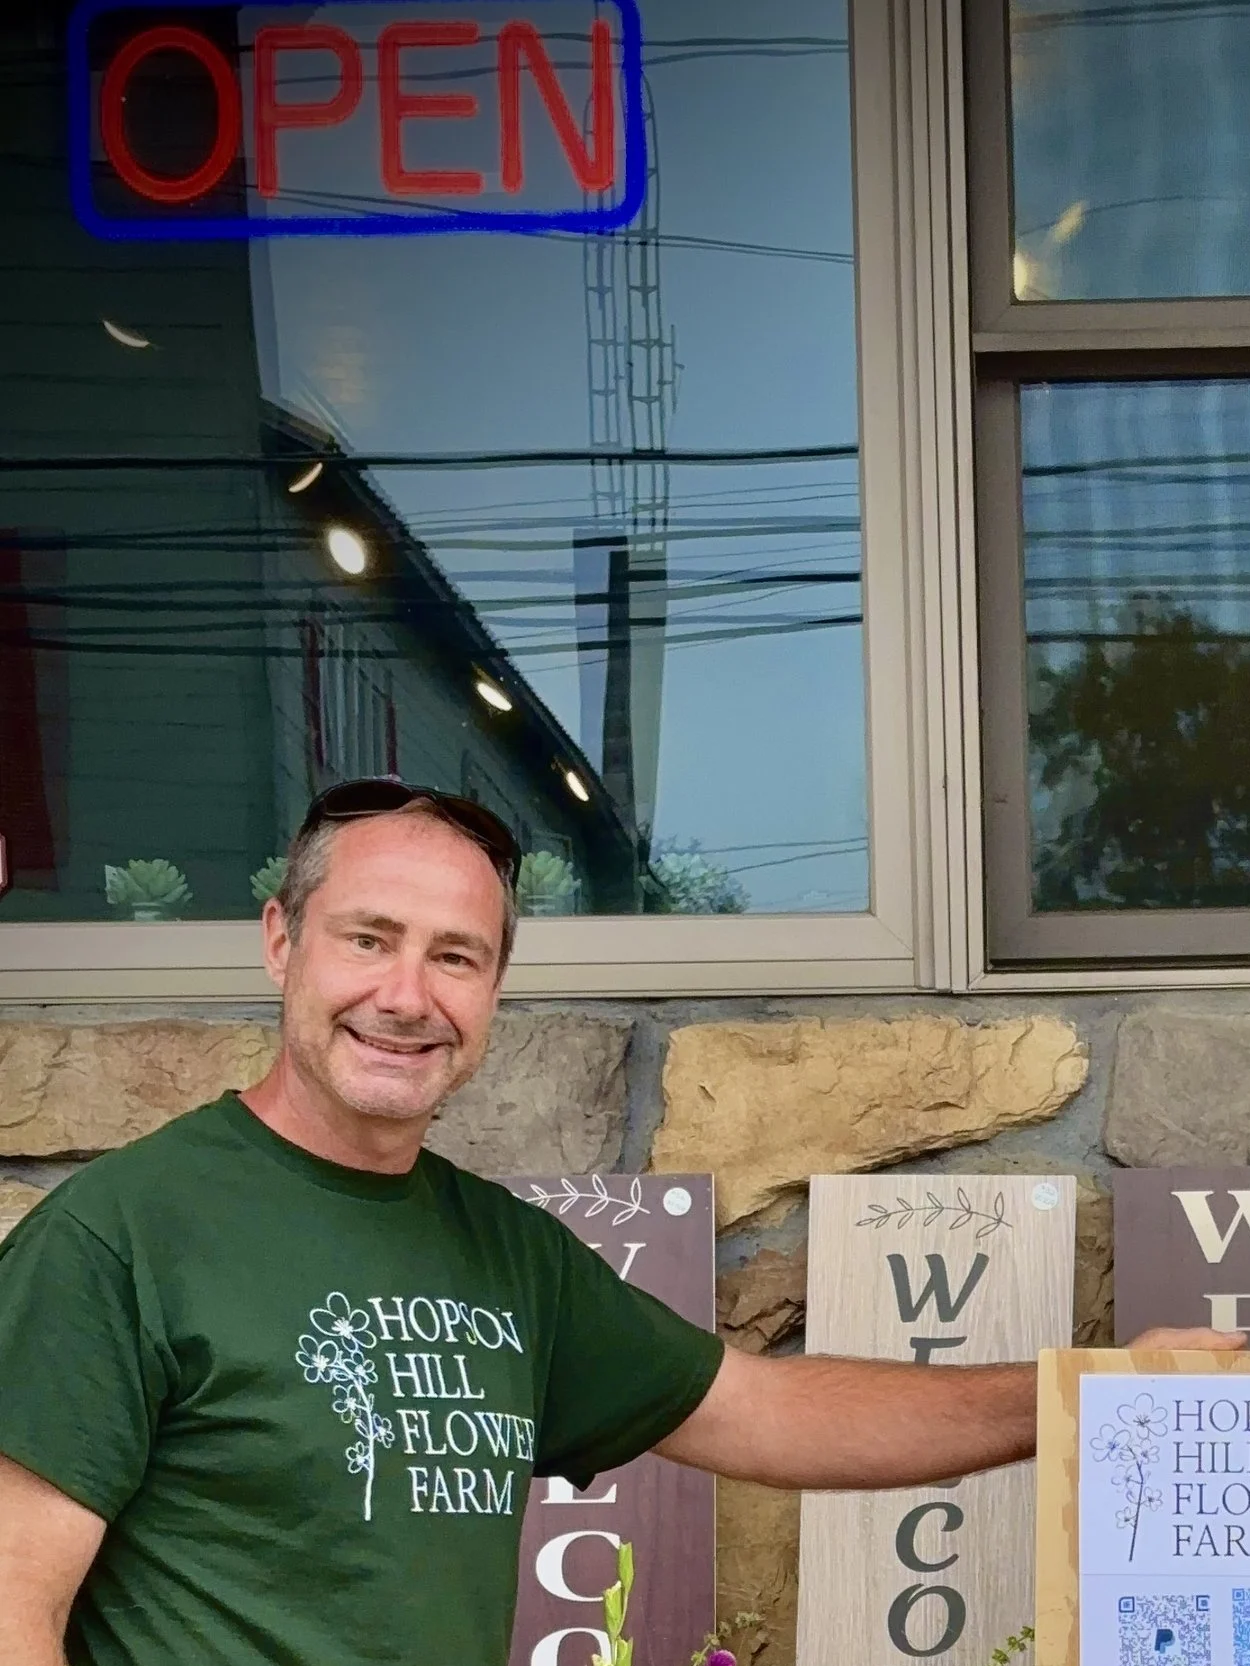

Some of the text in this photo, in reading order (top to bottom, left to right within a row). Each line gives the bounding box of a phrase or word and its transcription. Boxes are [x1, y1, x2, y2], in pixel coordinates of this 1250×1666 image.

[100, 18, 617, 204] OPEN
[386, 1352, 485, 1400] HILL
[407, 1466, 514, 1515] FARM
